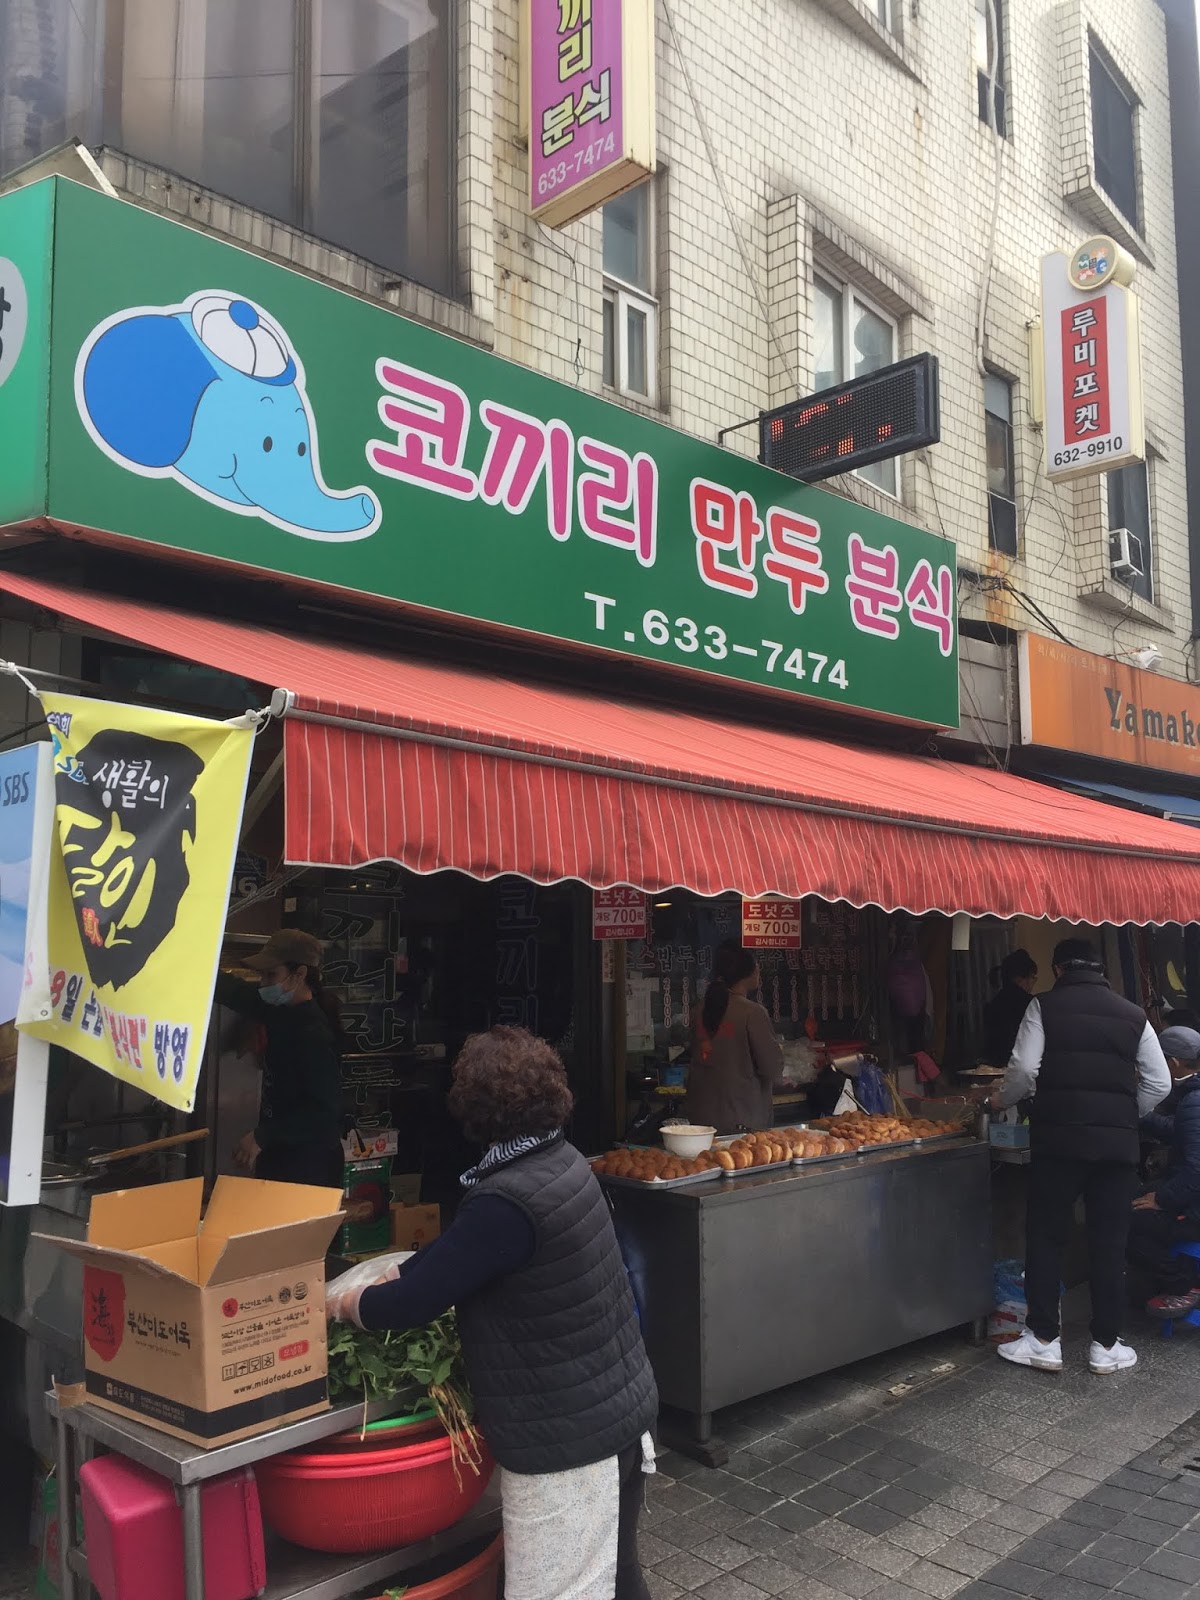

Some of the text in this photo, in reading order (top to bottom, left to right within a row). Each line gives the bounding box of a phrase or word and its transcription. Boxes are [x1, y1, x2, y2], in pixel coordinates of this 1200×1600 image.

[541, 67, 611, 158] 분식
[538, 131, 615, 195] 633-7474
[1071, 307, 1100, 435] 루비포켓
[1054, 436, 1123, 466] 632-9910
[365, 357, 658, 568] 코끼리
[690, 477, 829, 615] 만두
[845, 533, 953, 657] 분식
[1104, 687, 1200, 749] Yamak
[3, 771, 30, 807] SBS
[93, 759, 169, 809] 생활의
[599, 889, 640, 905] 도넛츠
[748, 904, 795, 918] 도넛츠
[744, 923, 760, 932] 개당
[755, 938, 788, 946] 감사합니다
[155, 1024, 188, 1083] 방영
[127, 1309, 191, 1350] 부산미도어묵
[233, 1364, 312, 1394] www.midofood.co.kr
